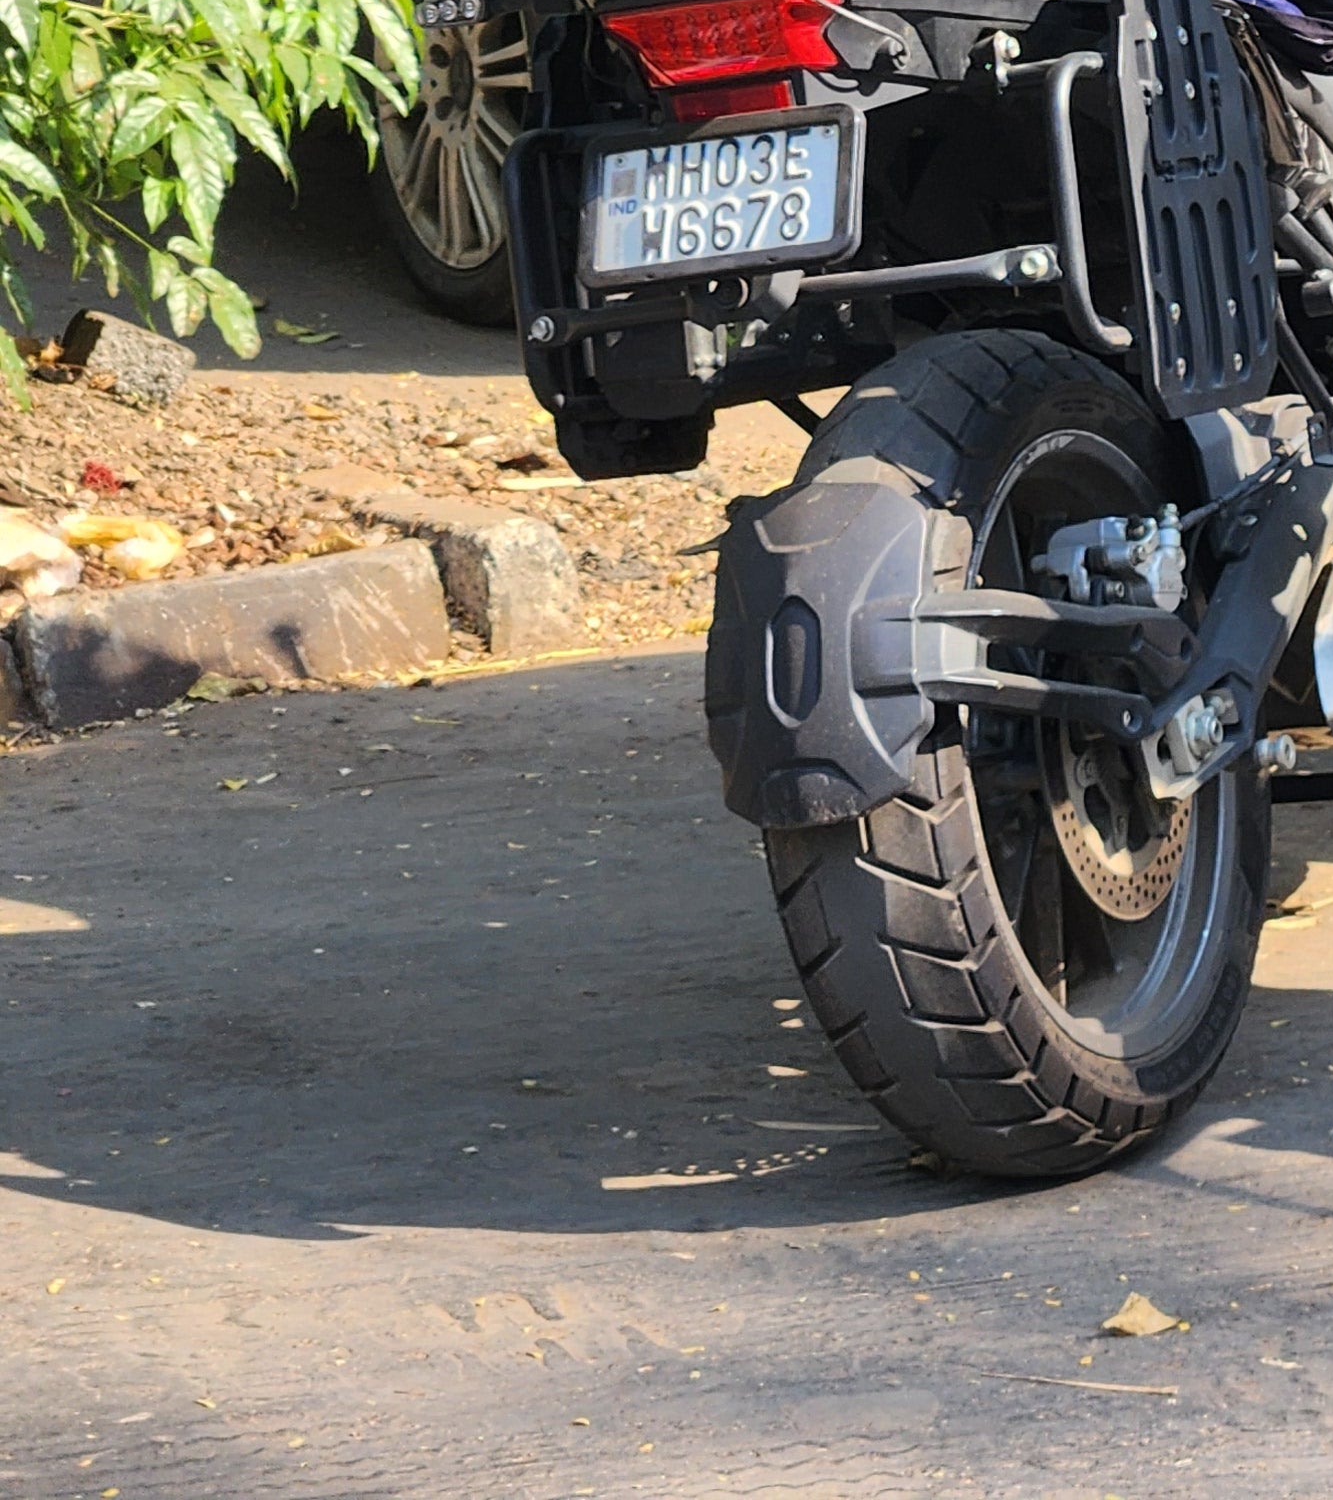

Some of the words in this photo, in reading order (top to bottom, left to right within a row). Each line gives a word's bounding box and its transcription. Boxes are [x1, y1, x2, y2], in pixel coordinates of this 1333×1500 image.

[645, 126, 813, 200] MH03E
[607, 199, 638, 217] IND
[641, 187, 810, 263] W6678
